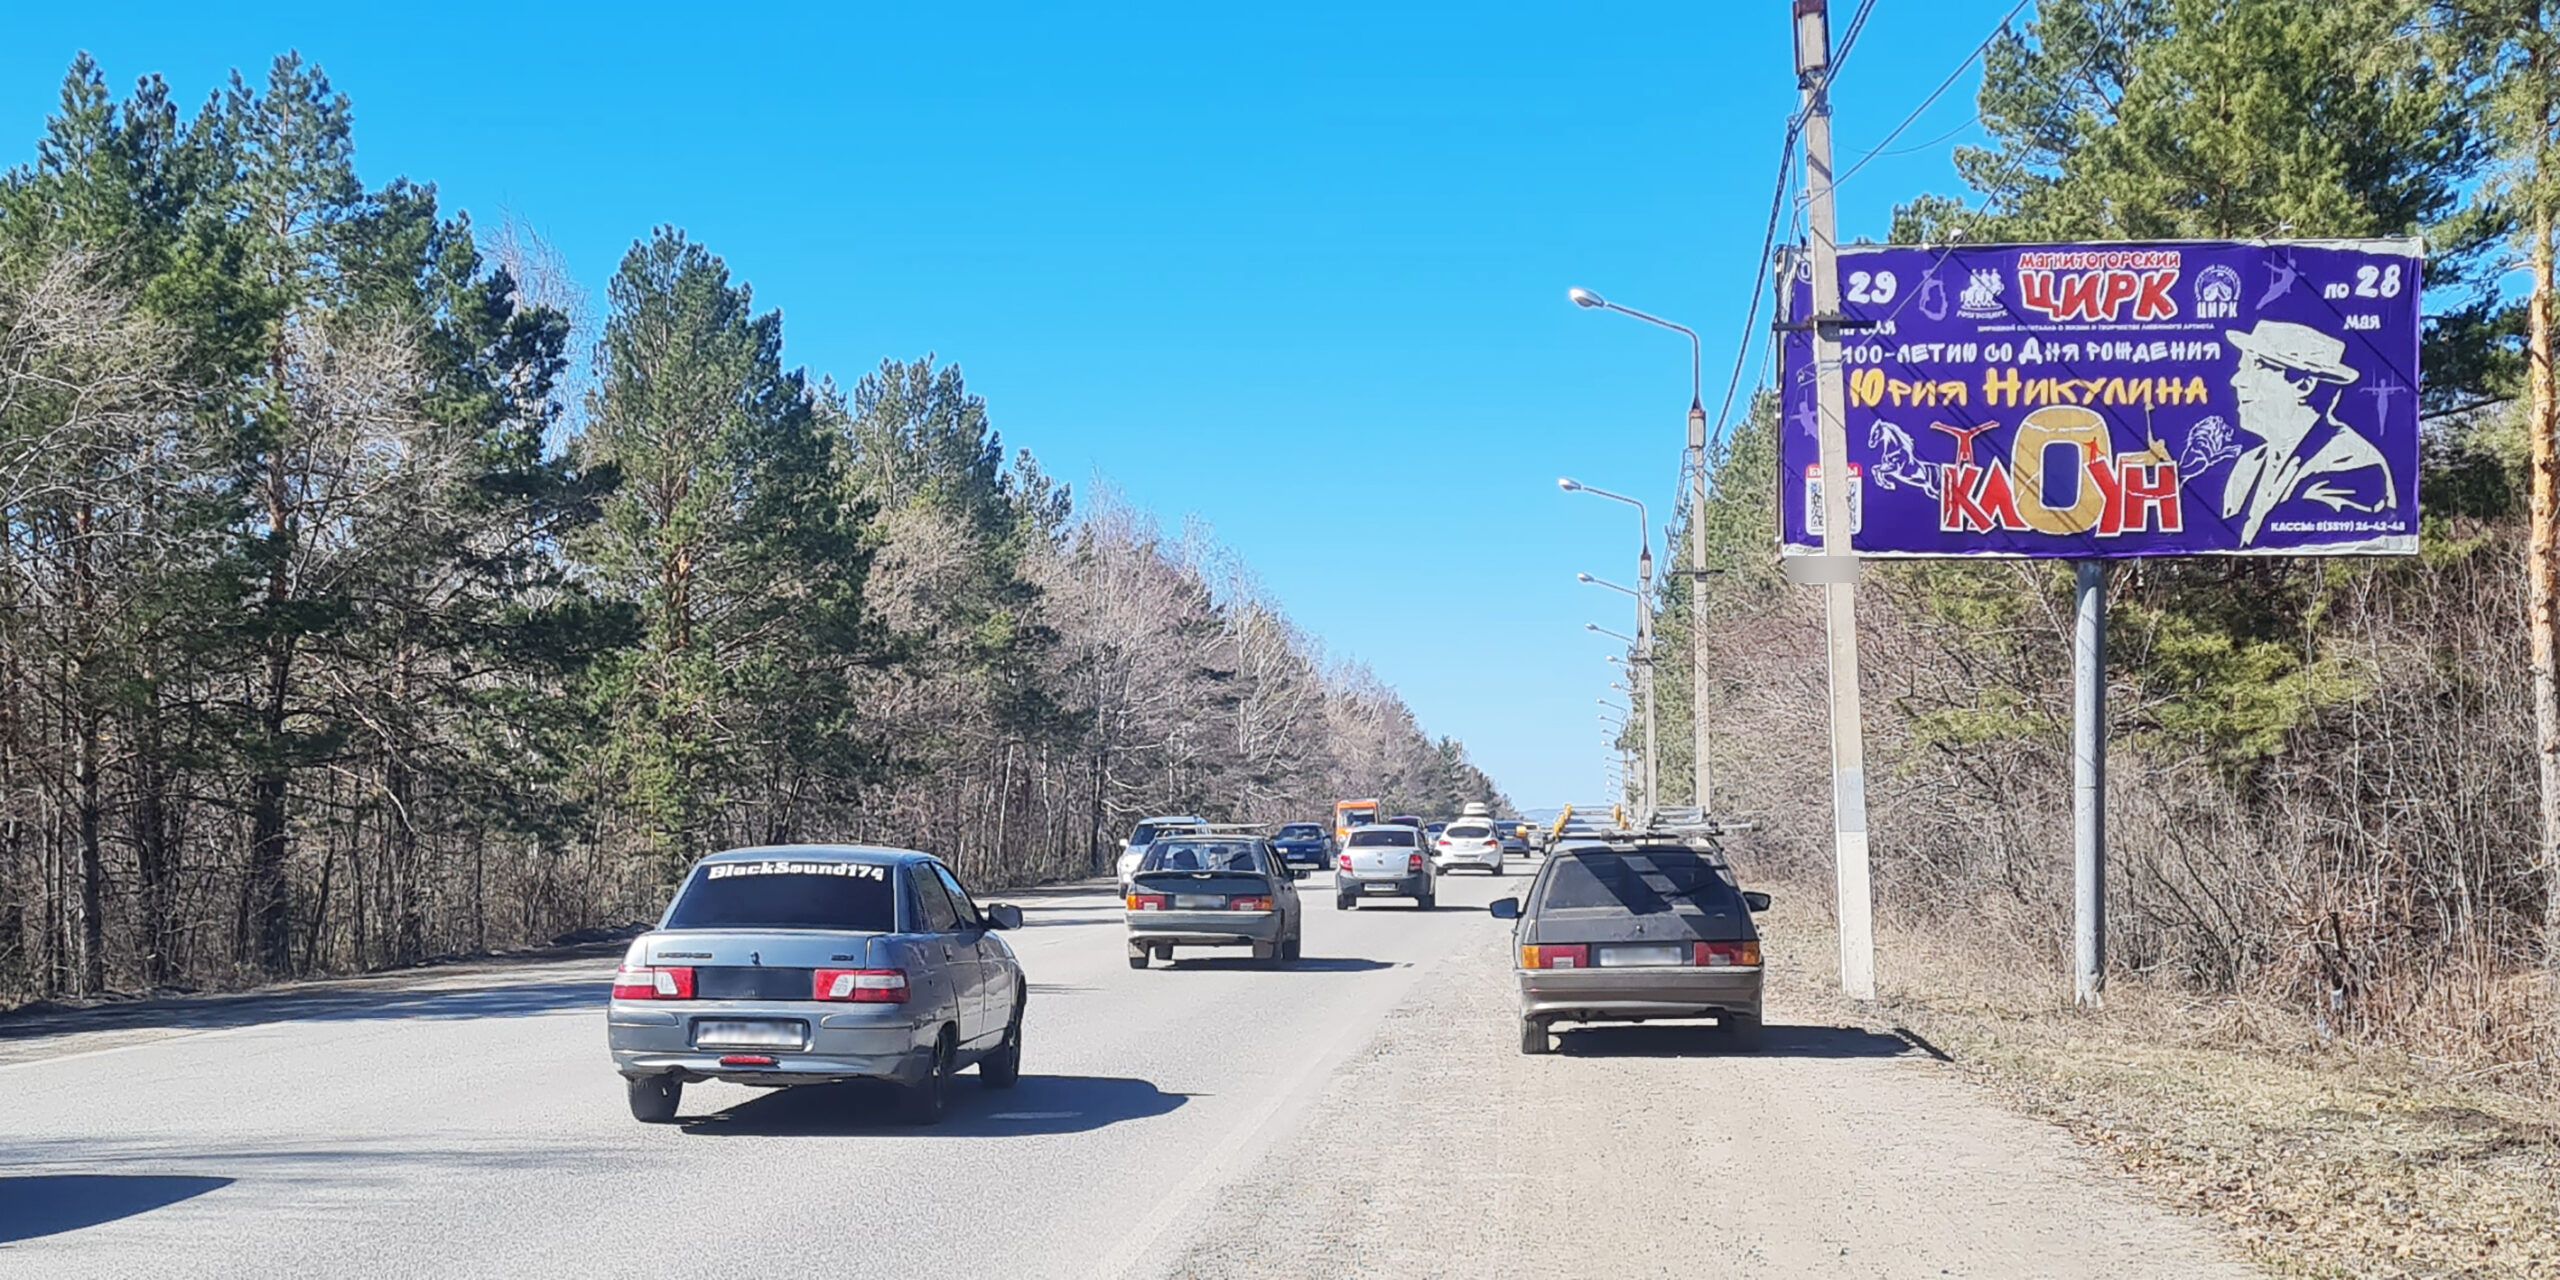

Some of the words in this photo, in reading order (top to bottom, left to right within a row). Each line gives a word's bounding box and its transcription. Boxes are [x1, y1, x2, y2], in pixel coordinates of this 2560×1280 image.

[1847, 271, 1897, 304] 29
[2018, 270, 2179, 322] ЦИРК
[2355, 264, 2401, 298] 28
[2197, 301, 2237, 318] ЦИРК
[2086, 341, 2221, 363] РОЖДЕНИЯ
[1940, 405, 2183, 537] КЛОУН
[708, 862, 885, 881] BlackSound174
